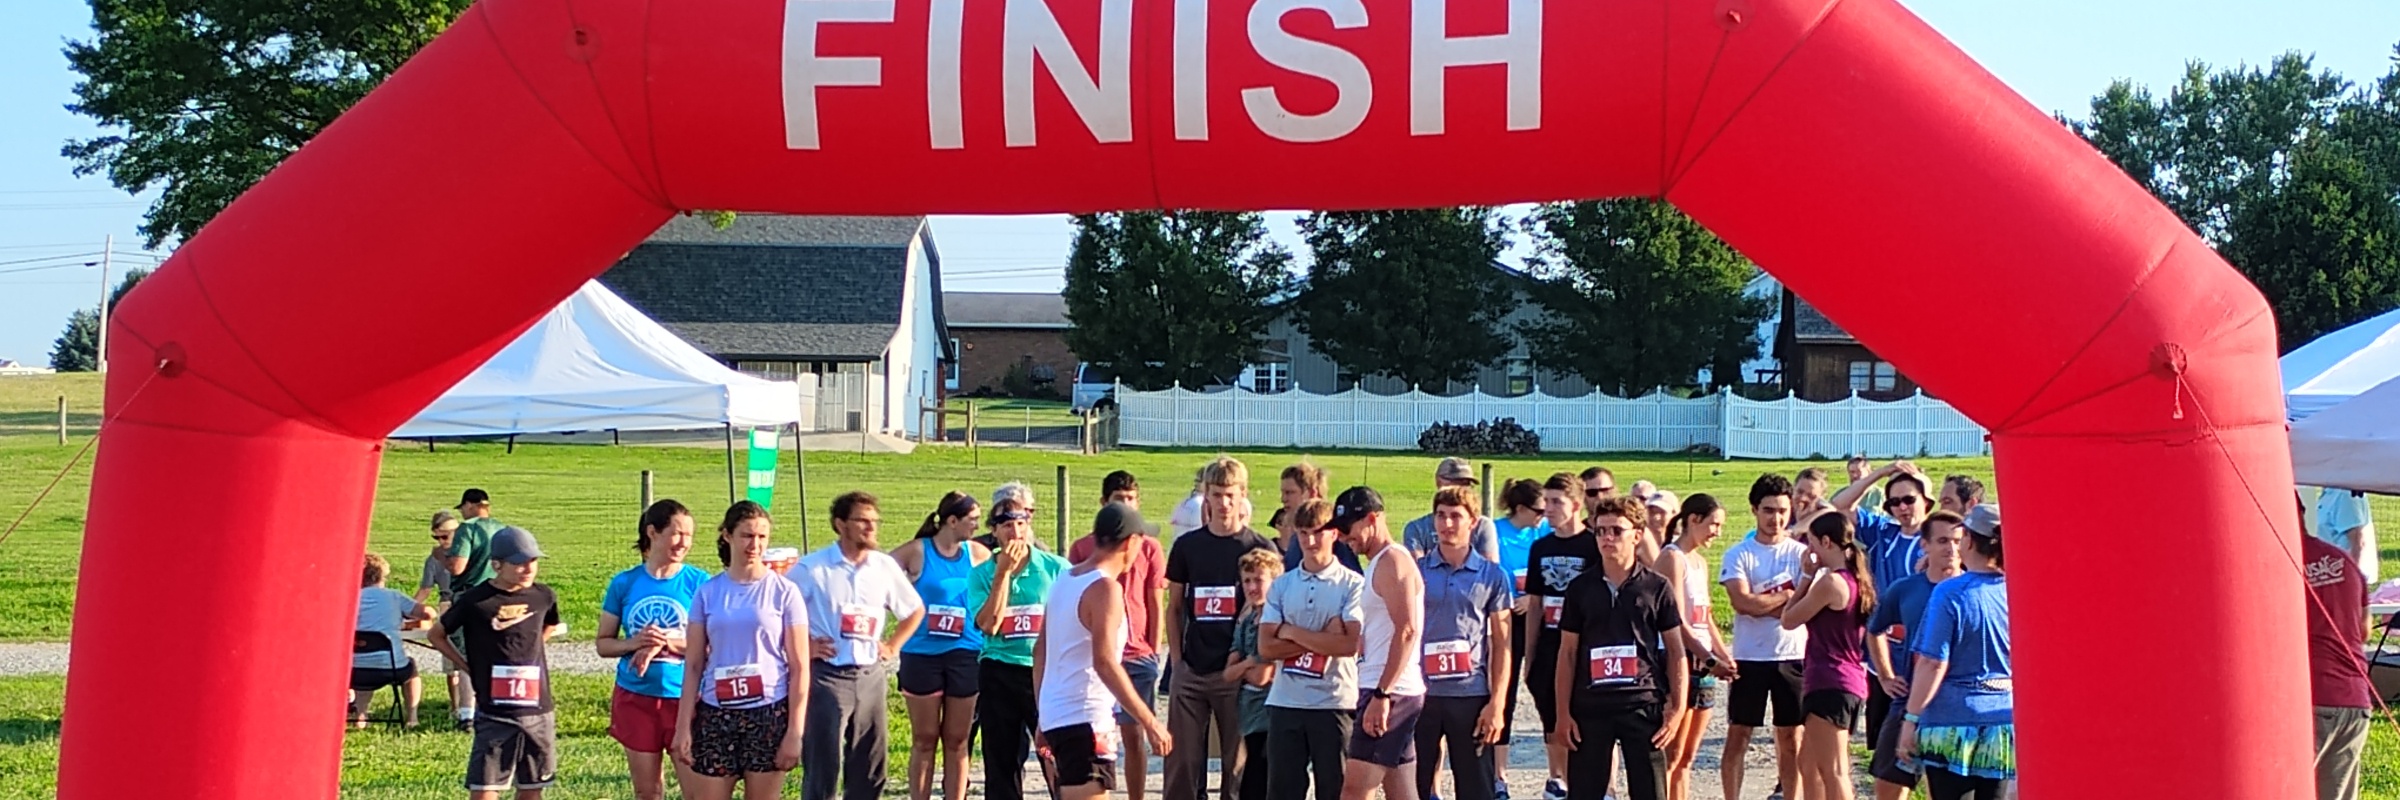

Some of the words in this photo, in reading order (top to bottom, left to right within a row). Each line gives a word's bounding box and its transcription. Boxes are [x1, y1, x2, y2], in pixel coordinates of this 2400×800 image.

[782, 0, 1541, 150] FINISH
[1205, 598, 1221, 614] 42
[938, 616, 954, 631] 47
[1014, 615, 1031, 632] 26
[1438, 654, 1457, 671] 31
[1604, 658, 1623, 676] 34
[508, 679, 527, 698] 14
[729, 678, 749, 697] 15
